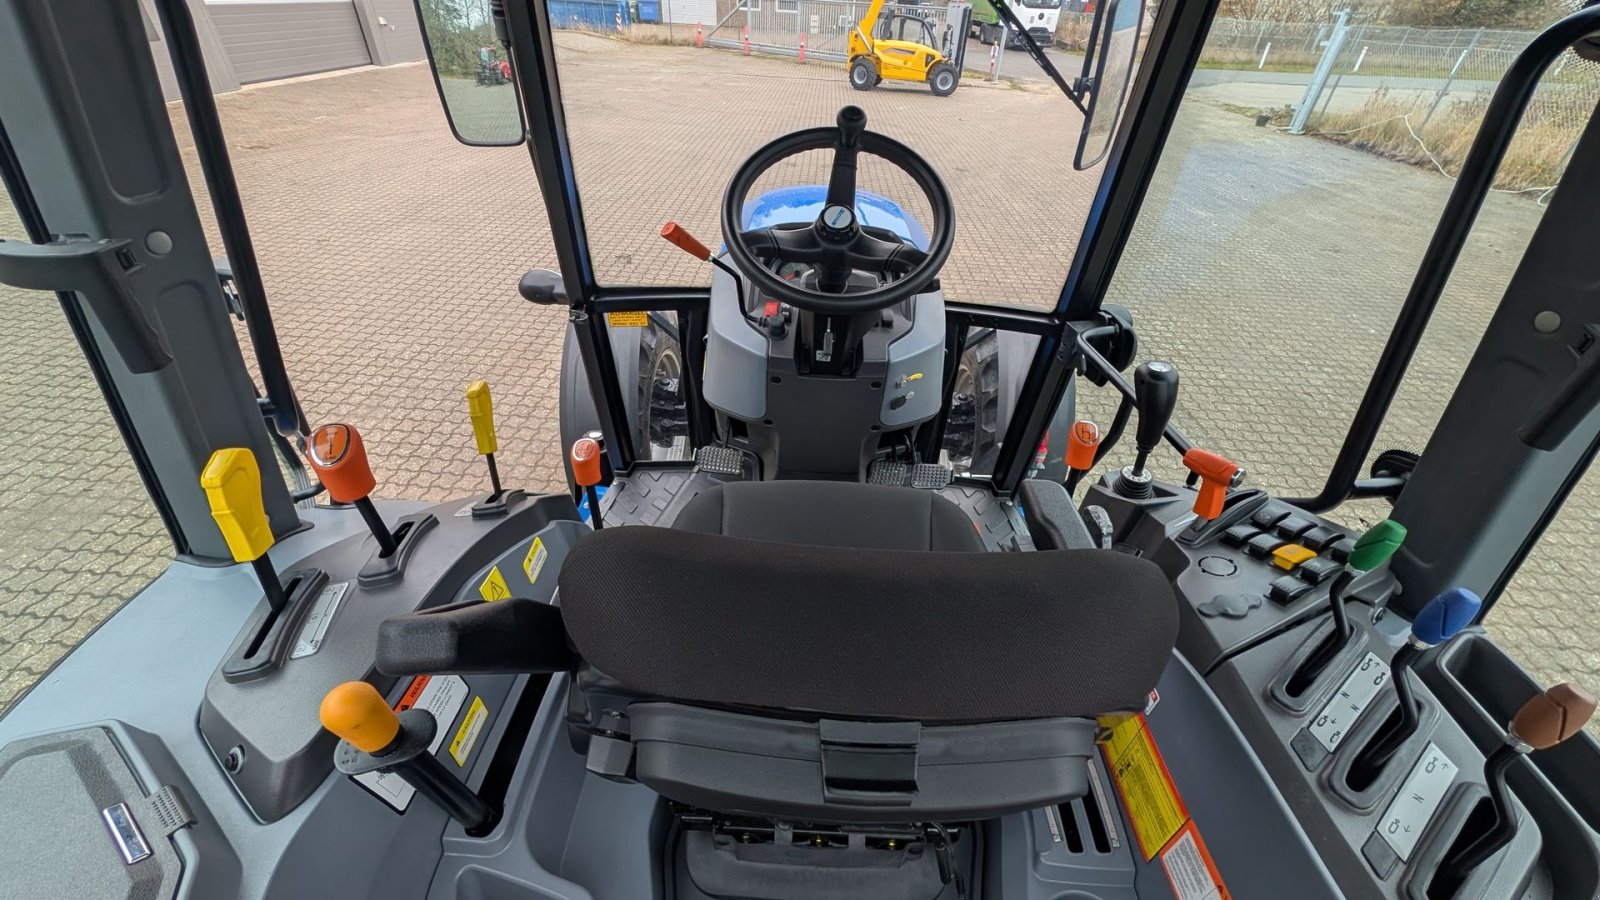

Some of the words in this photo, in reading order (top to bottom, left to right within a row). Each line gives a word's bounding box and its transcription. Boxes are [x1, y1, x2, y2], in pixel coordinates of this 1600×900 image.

[1340, 690, 1350, 699] N
[1350, 703, 1360, 713] N
[1412, 793, 1425, 804] N
